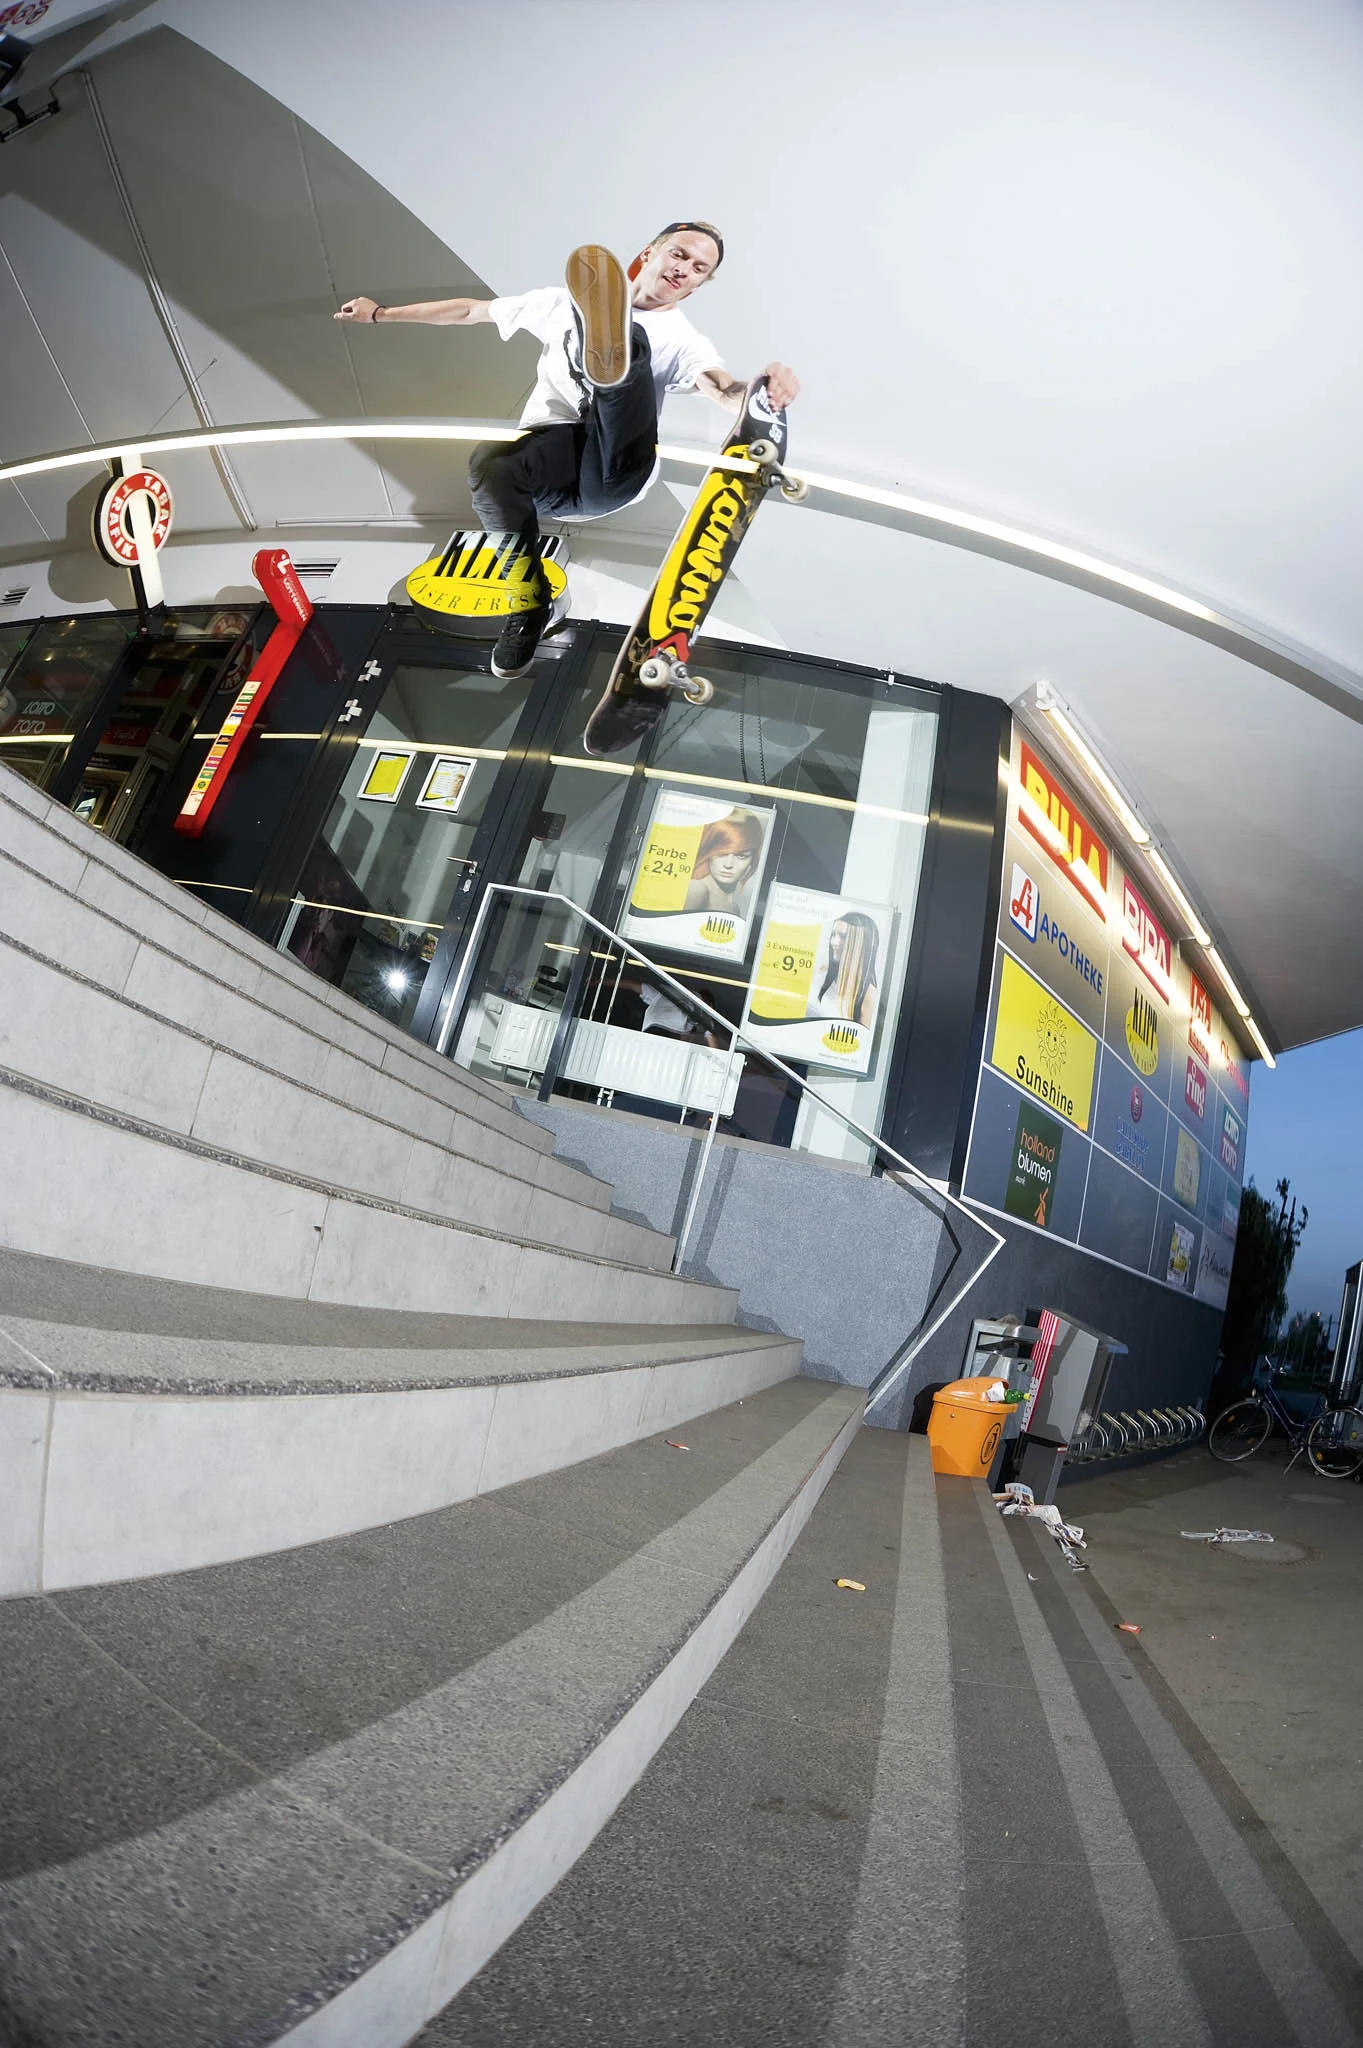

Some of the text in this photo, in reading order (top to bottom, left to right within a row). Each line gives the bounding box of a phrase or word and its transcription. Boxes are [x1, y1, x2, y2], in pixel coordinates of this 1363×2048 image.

[769, 423, 783, 443] SB
[109, 484, 135, 558] TRAFIK
[143, 475, 170, 540] TABAK
[433, 531, 560, 582] KLIPP
[11, 719, 46, 734] TOTO
[1026, 761, 1101, 885] BILLA
[648, 844, 688, 860] Farbe
[705, 915, 735, 935] KLIPP
[1124, 889, 1171, 977] BIPA
[1040, 912, 1103, 996] APOTHEKE
[829, 1023, 858, 1044] KLIPP
[1132, 987, 1158, 1051] KLIPP
[1016, 1055, 1074, 1116] Sunshine
[1186, 1064, 1206, 1119] ring
[1017, 1149, 1052, 1184] blumen
[1020, 1128, 1056, 1162] holland
[1222, 1138, 1237, 1171] TOTO
